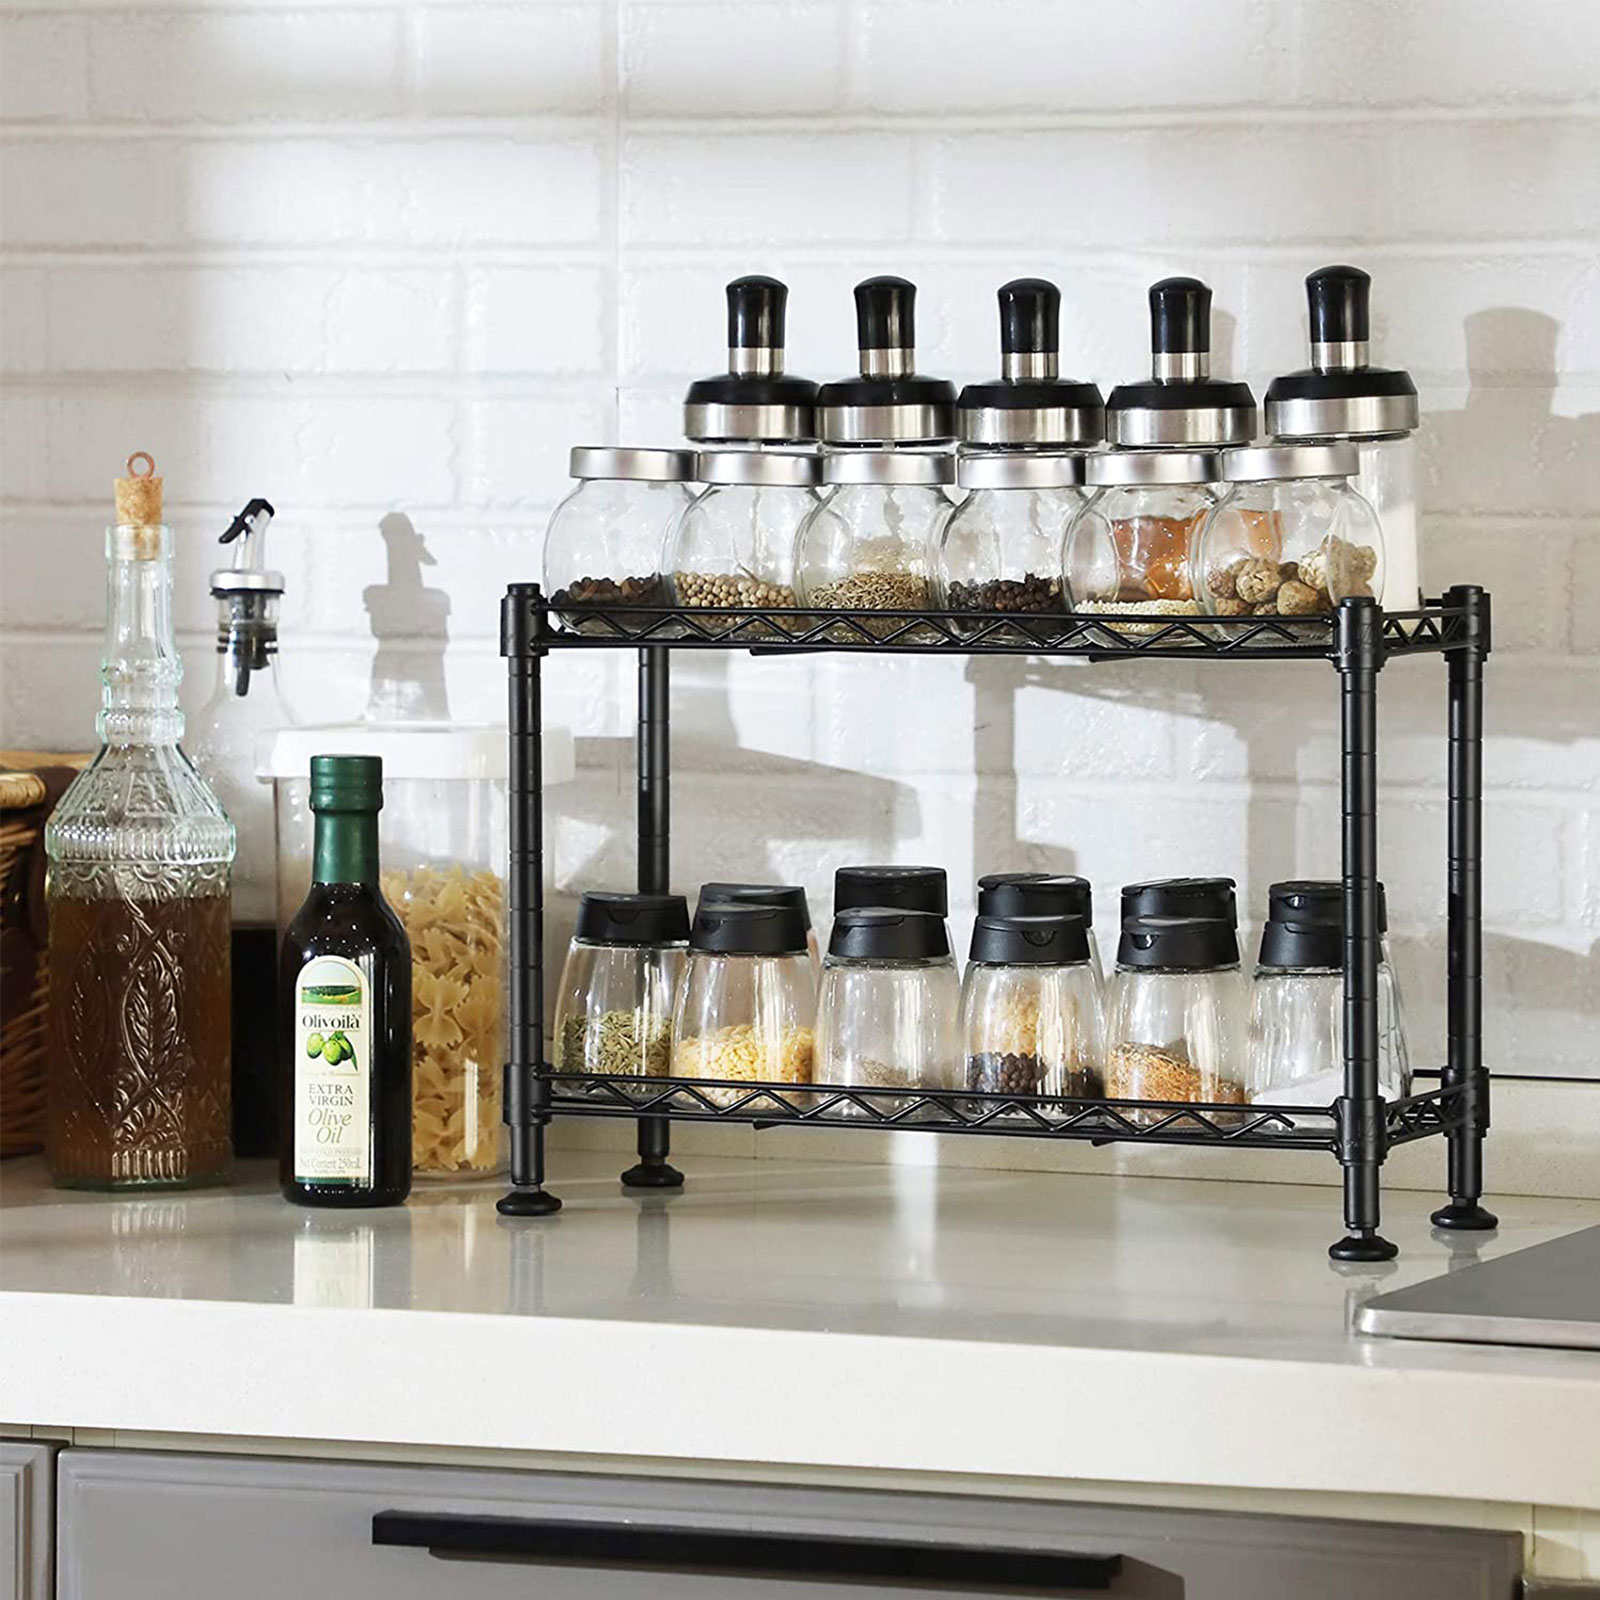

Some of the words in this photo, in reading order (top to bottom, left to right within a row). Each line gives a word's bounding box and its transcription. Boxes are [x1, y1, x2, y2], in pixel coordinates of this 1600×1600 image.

[308, 1083, 353, 1095] EXTRA
[309, 1095, 353, 1107] VIRGIN
[308, 1107, 352, 1127] Olive
[316, 1126, 343, 1144] Oil
